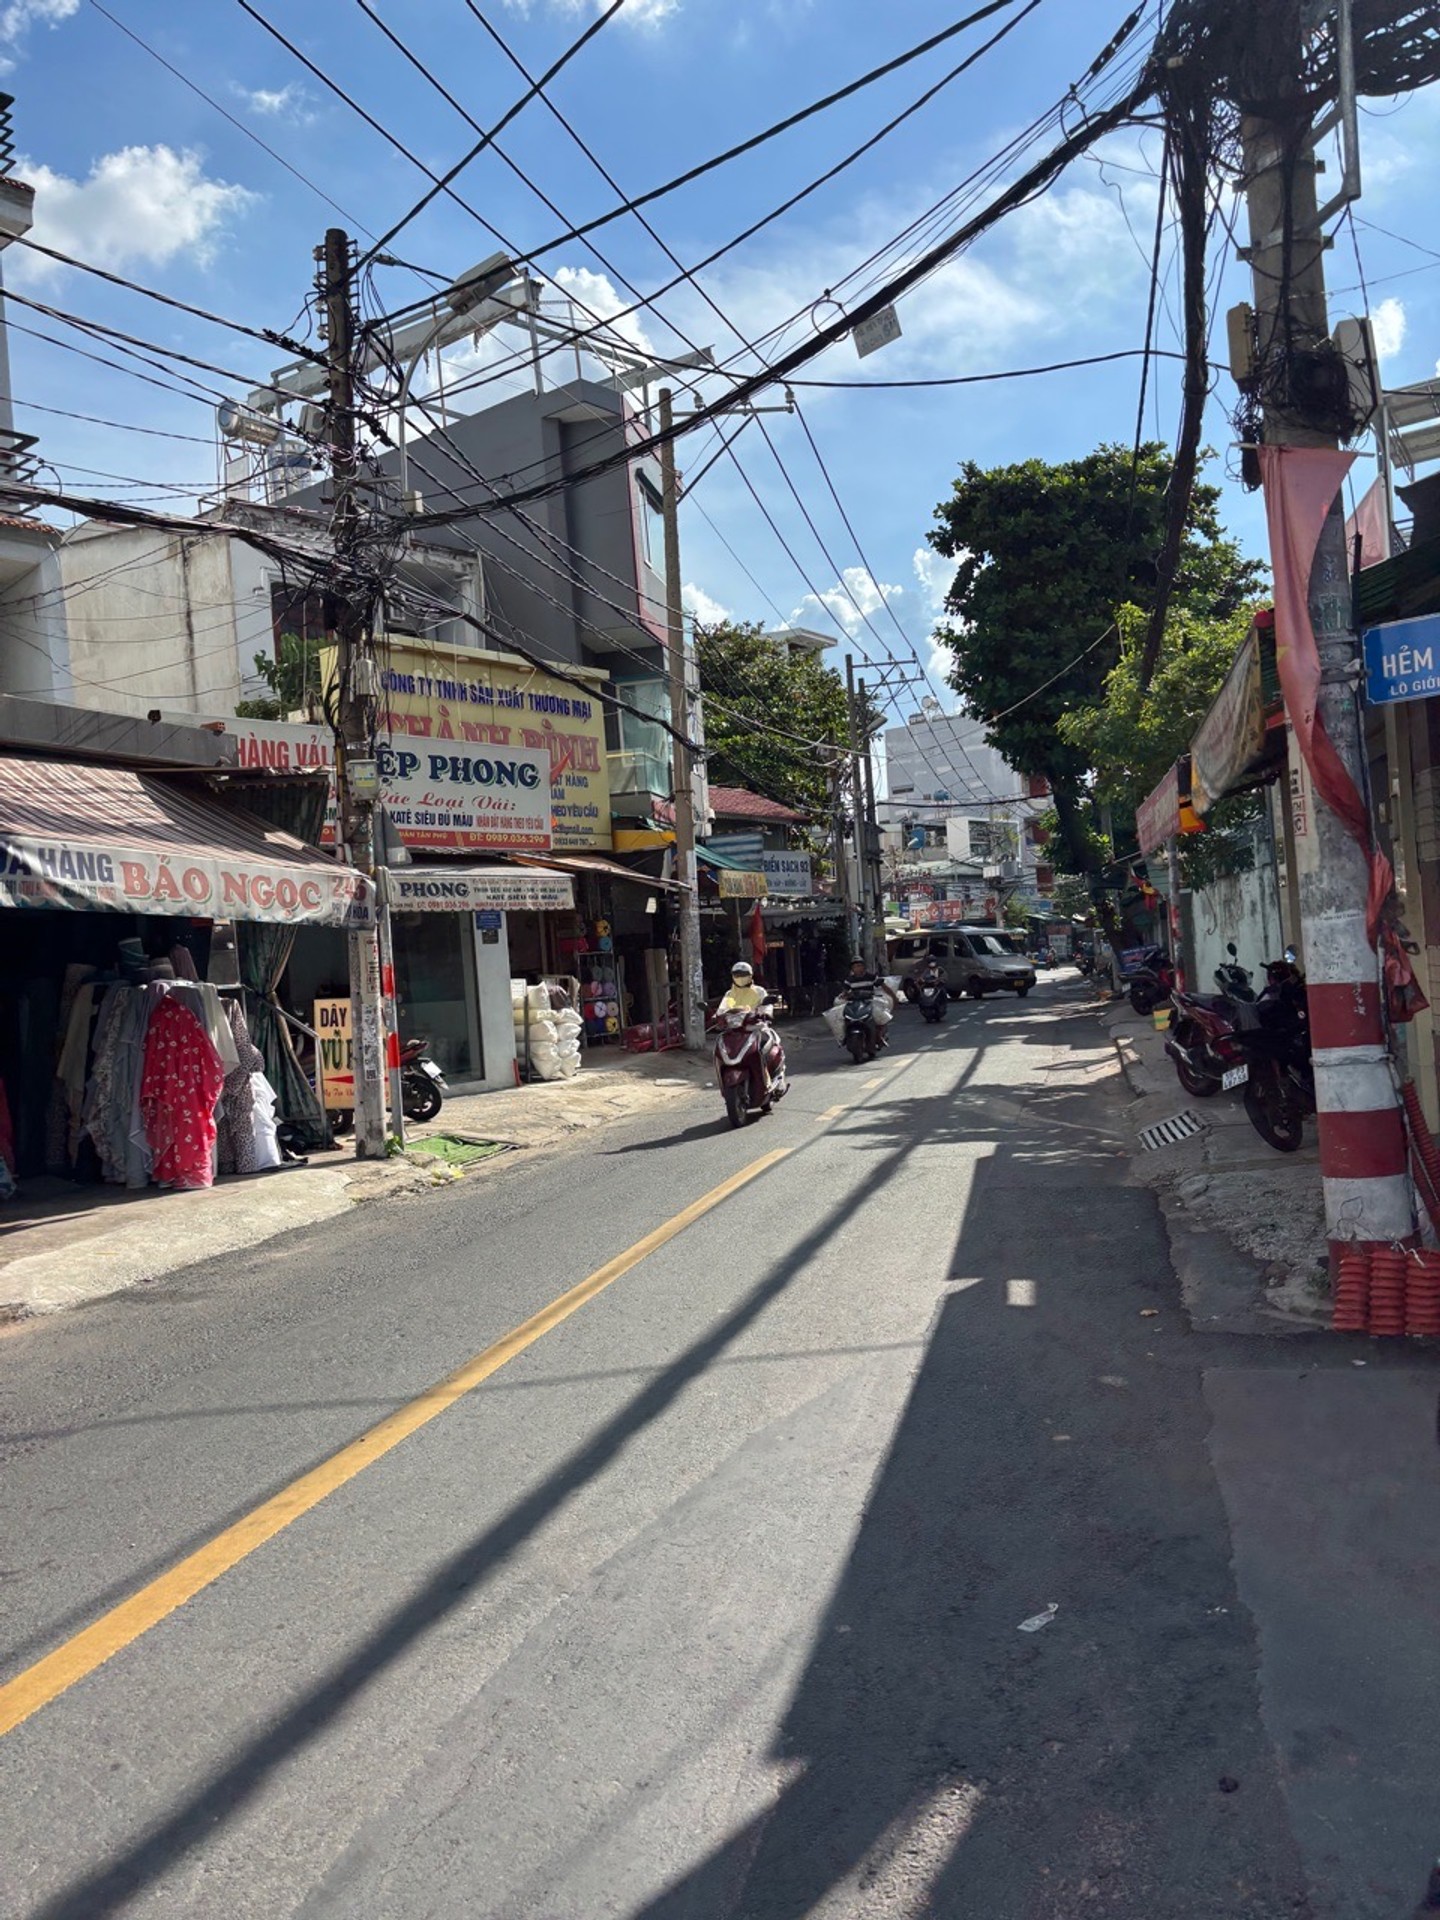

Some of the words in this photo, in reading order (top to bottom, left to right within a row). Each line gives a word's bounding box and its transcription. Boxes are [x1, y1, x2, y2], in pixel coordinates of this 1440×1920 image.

[1382, 645, 1433, 678] HẺM
[381, 668, 415, 694] CÔNG
[418, 676, 432, 696] TY
[436, 679, 467, 701] TNHH
[571, 699, 592, 724] MẠI
[237, 732, 289, 768] HÀNG
[295, 734, 328, 766] VẢI
[429, 754, 541, 791] PHONG
[415, 791, 464, 810] Loại
[414, 810, 436, 826] SIÊU
[453, 811, 473, 828] MÀU
[38, 844, 114, 883] HÀNG
[221, 871, 322, 917] NGỌC
[399, 882, 469, 898] PHONG
[320, 1003, 347, 1027] DÂY
